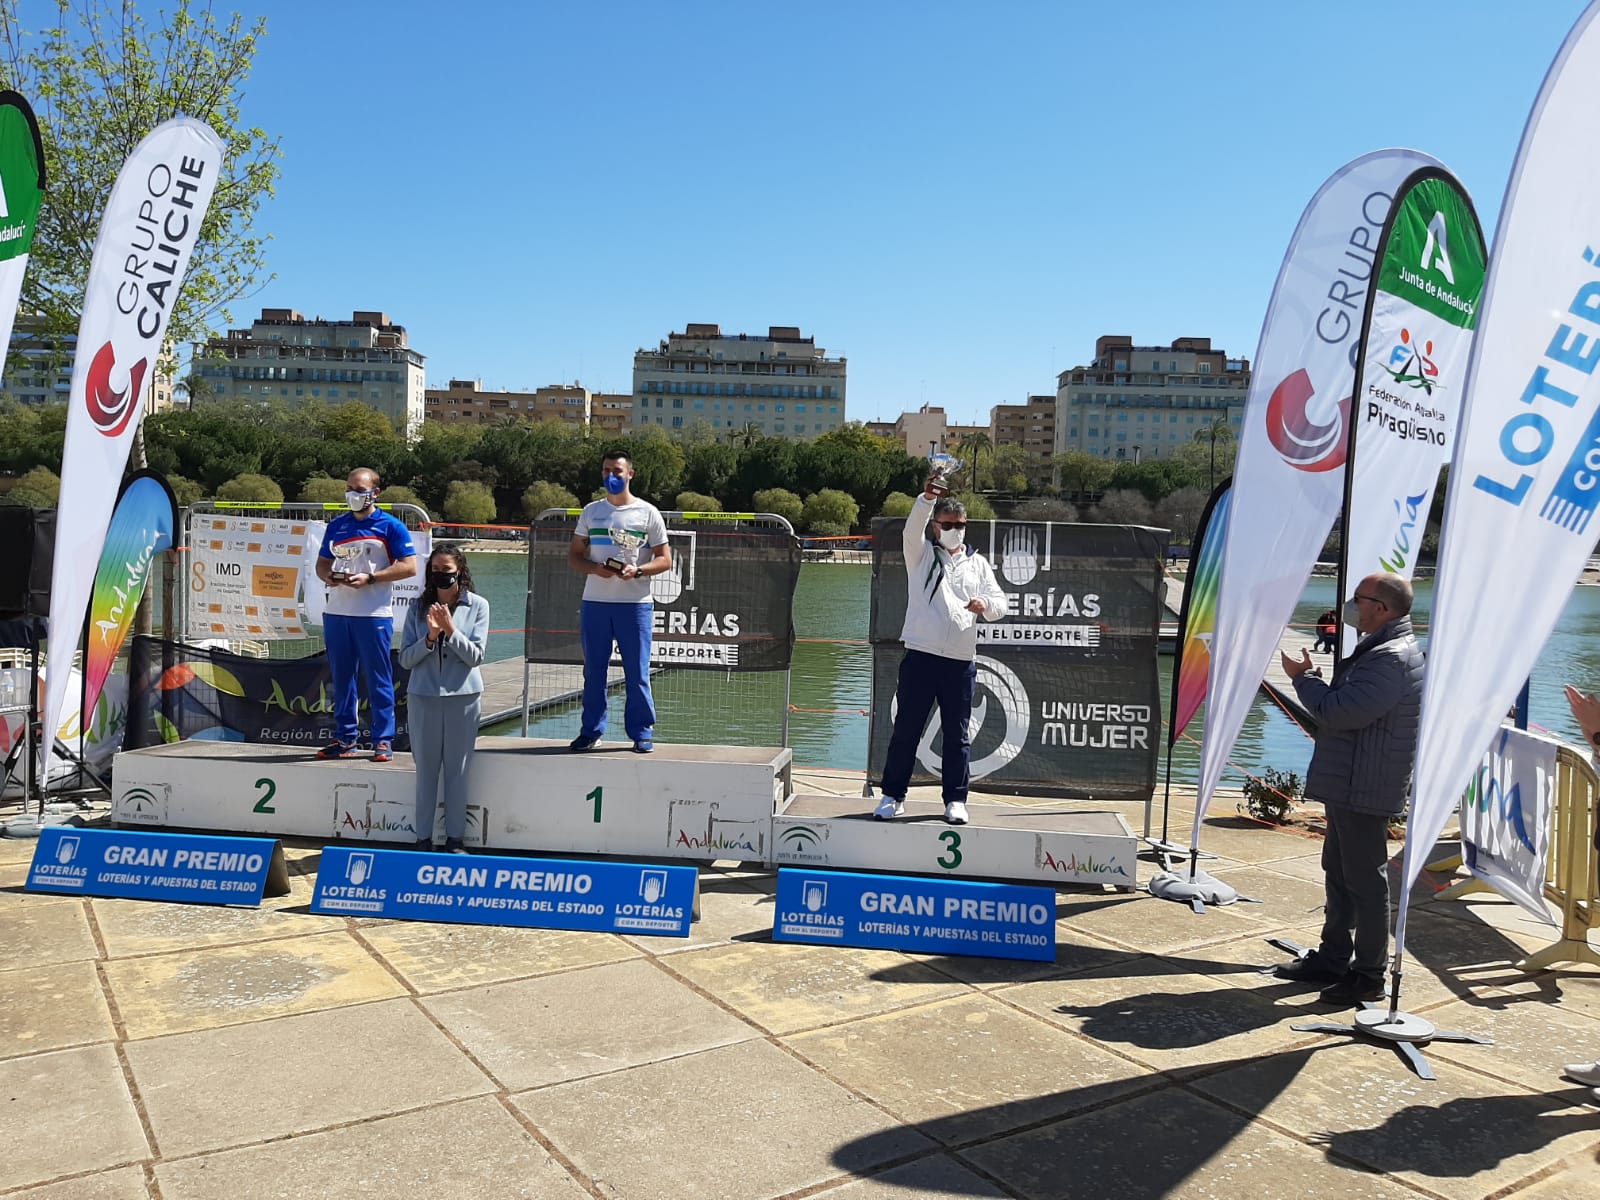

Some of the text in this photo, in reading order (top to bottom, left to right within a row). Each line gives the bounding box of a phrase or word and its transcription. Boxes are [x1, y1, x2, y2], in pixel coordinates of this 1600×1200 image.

[117, 163, 172, 315] GRUPO
[138, 155, 205, 340] CALICHE
[1316, 190, 1394, 345] GRUPO
[1399, 266, 1424, 290] Junta
[1425, 280, 1436, 297] de
[1472, 245, 1600, 507] LOTER
[1573, 437, 1600, 491] CO
[215, 562, 242, 576] IMD
[1005, 588, 1101, 618] ERÍAS
[652, 607, 740, 636] ERÍAS
[992, 629, 1008, 639] EL
[1013, 629, 1082, 641] DEPORTE
[658, 647, 721, 659] DEPORTE
[1042, 702, 1150, 722] UNIVERSO
[260, 728, 313, 744] Región
[1041, 723, 1150, 750] MUJER
[252, 778, 277, 814] 2
[585, 786, 603, 823] 1
[342, 811, 417, 834] Andalucía
[675, 829, 758, 853] Andalucía
[937, 831, 963, 870] 3
[34, 864, 88, 877] LOTERÍAS
[104, 845, 263, 873] GRAN PREMIO
[1041, 851, 1130, 877] Andalucía
[97, 872, 257, 892] LOTERÍAS Y APUESTAS DEL ESTADO
[321, 885, 387, 900] LOTERÍAS
[417, 865, 593, 894] GRAN PREMIO
[396, 892, 605, 915] LOTERÍAS Y APUESTAS DEL ESTADO
[615, 904, 683, 918] LOTERÍAS
[860, 891, 1048, 925] GRAN PREMIO
[781, 912, 845, 926] LOTERÍAS
[858, 921, 1048, 946] LOTERÍAS Y APUESTAS DEL ESTADO
